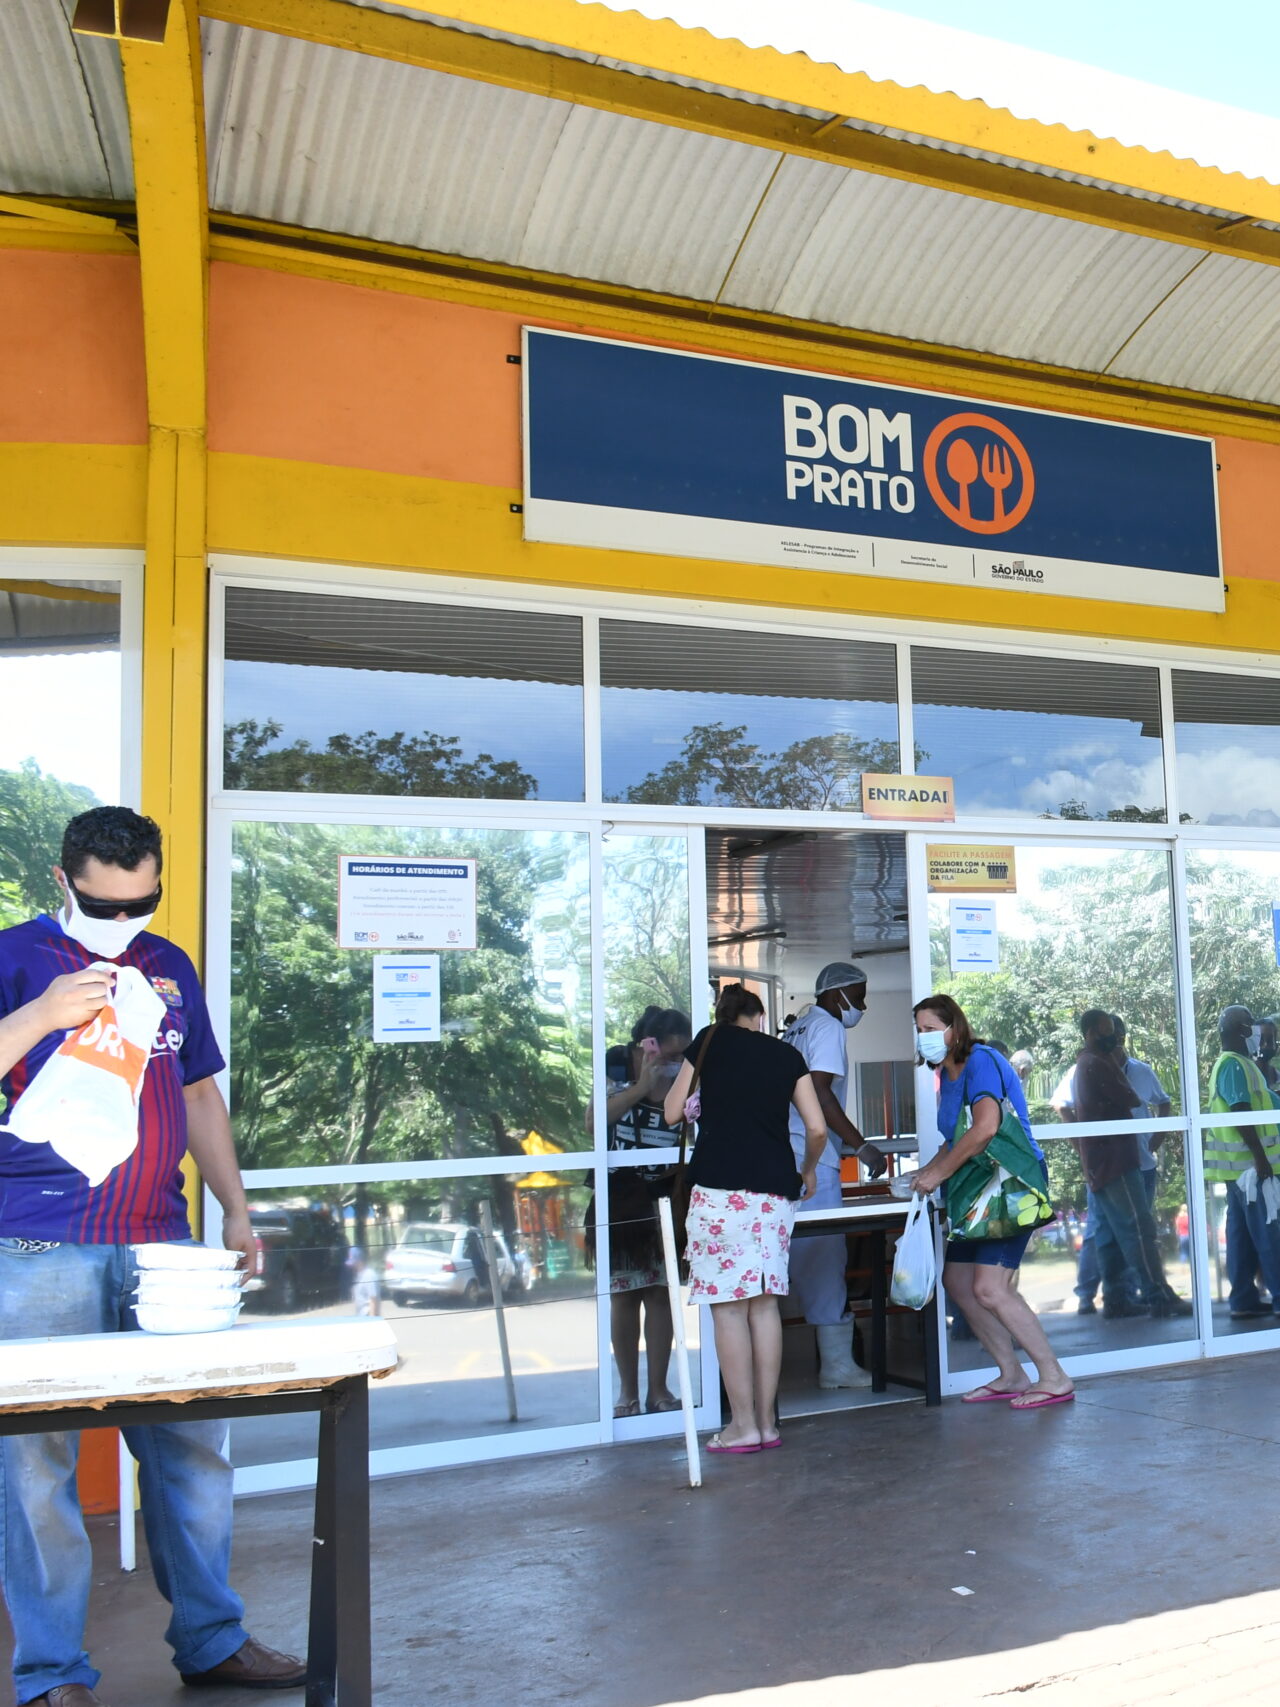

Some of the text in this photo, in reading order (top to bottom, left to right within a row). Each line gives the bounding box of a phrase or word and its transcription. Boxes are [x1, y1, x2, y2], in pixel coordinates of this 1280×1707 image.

[783, 394, 914, 473] BOM
[785, 460, 916, 514] PRATO
[991, 563, 1044, 579] SÃO PAULO
[929, 850, 960, 858] FACILITE
[970, 851, 1012, 859] PASSAGEM
[352, 864, 394, 874] HORÁRIOS
[407, 867, 465, 876] ATENDIMENTO
[929, 866, 979, 874] ORGANIZAÇÃO
